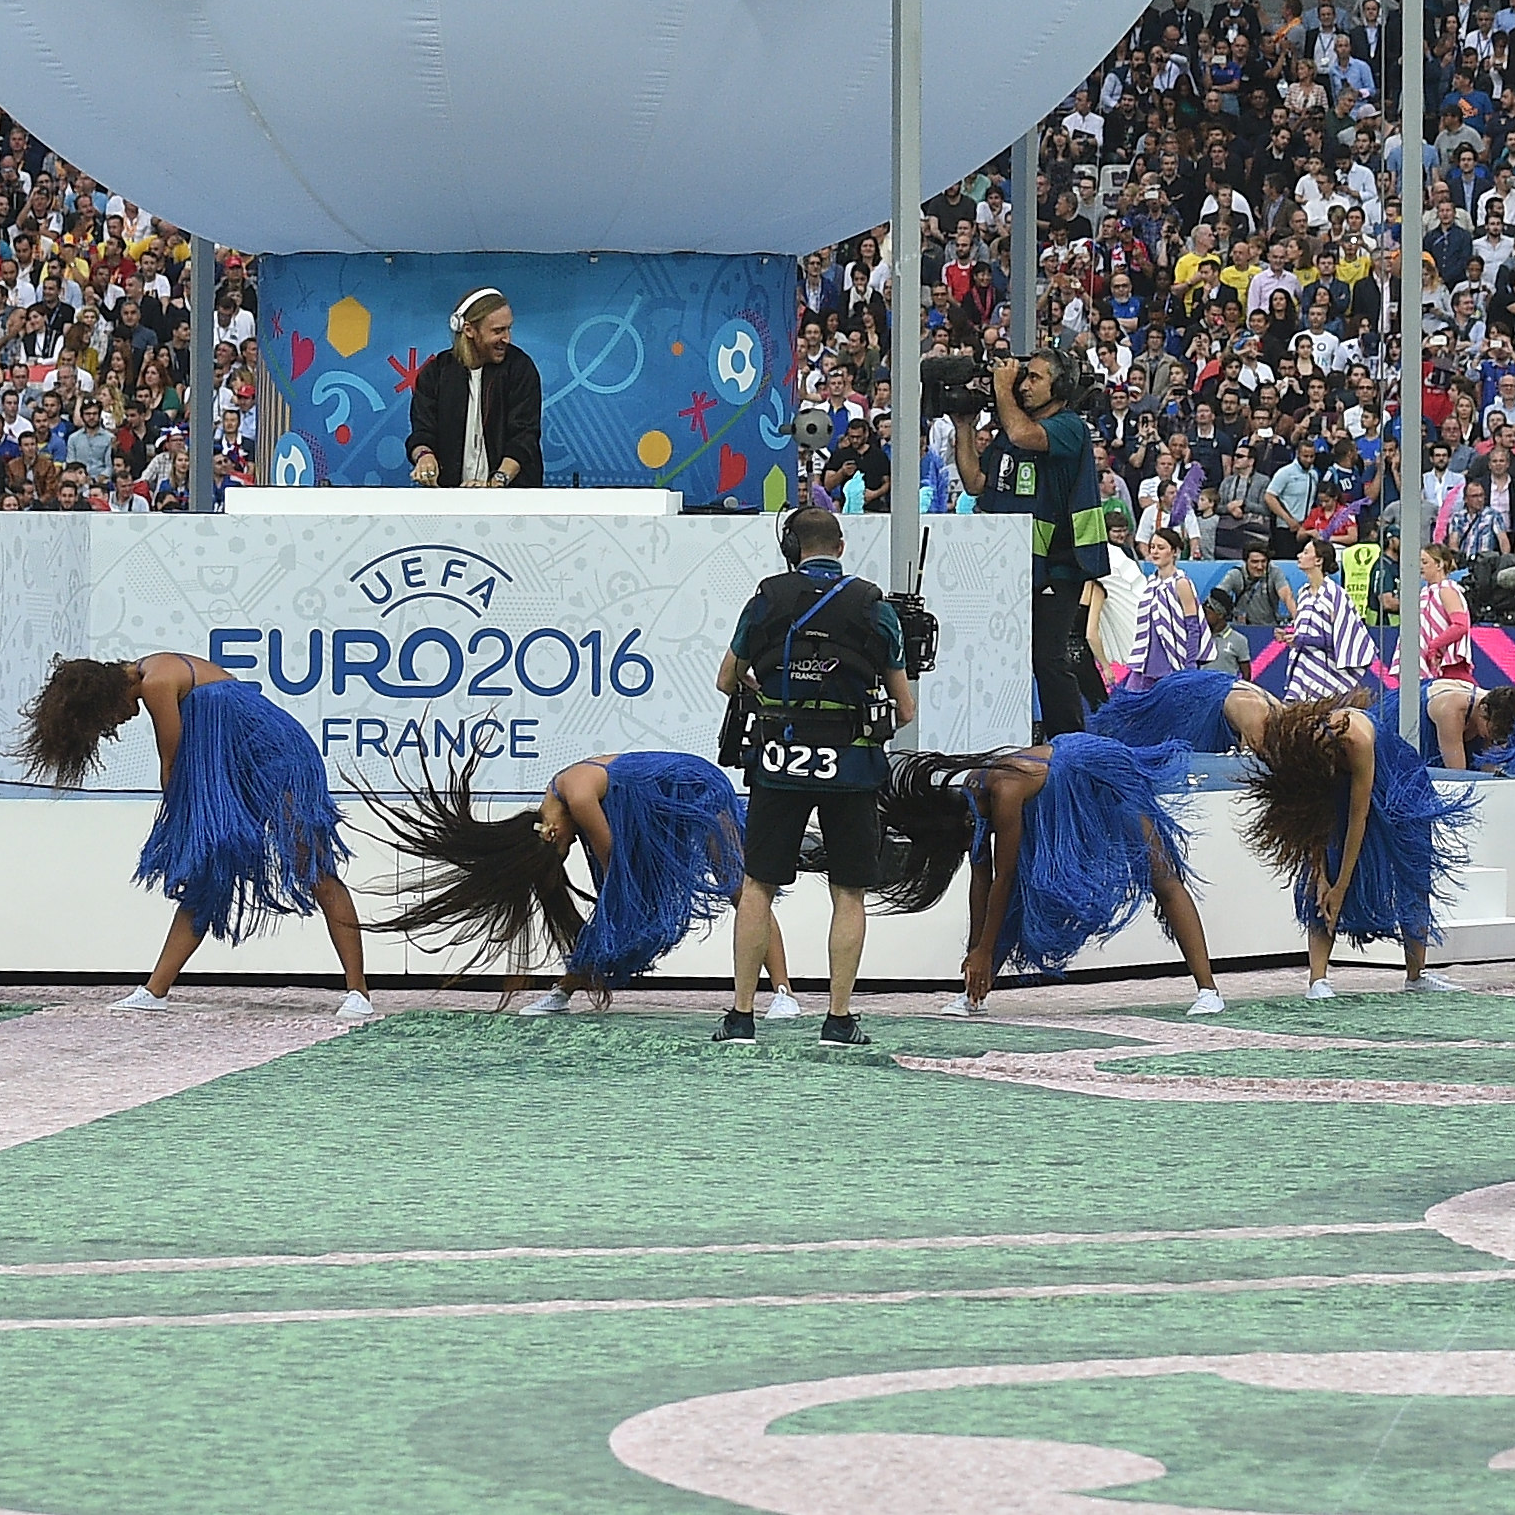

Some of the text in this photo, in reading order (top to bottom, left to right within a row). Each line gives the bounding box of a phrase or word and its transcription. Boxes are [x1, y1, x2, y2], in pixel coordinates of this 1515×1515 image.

[1338, 477, 1353, 492] 10
[358, 555, 498, 610] UEFA
[790, 671, 824, 682] FRANCE
[322, 717, 541, 760] FRANCE
[761, 739, 840, 780] 023
